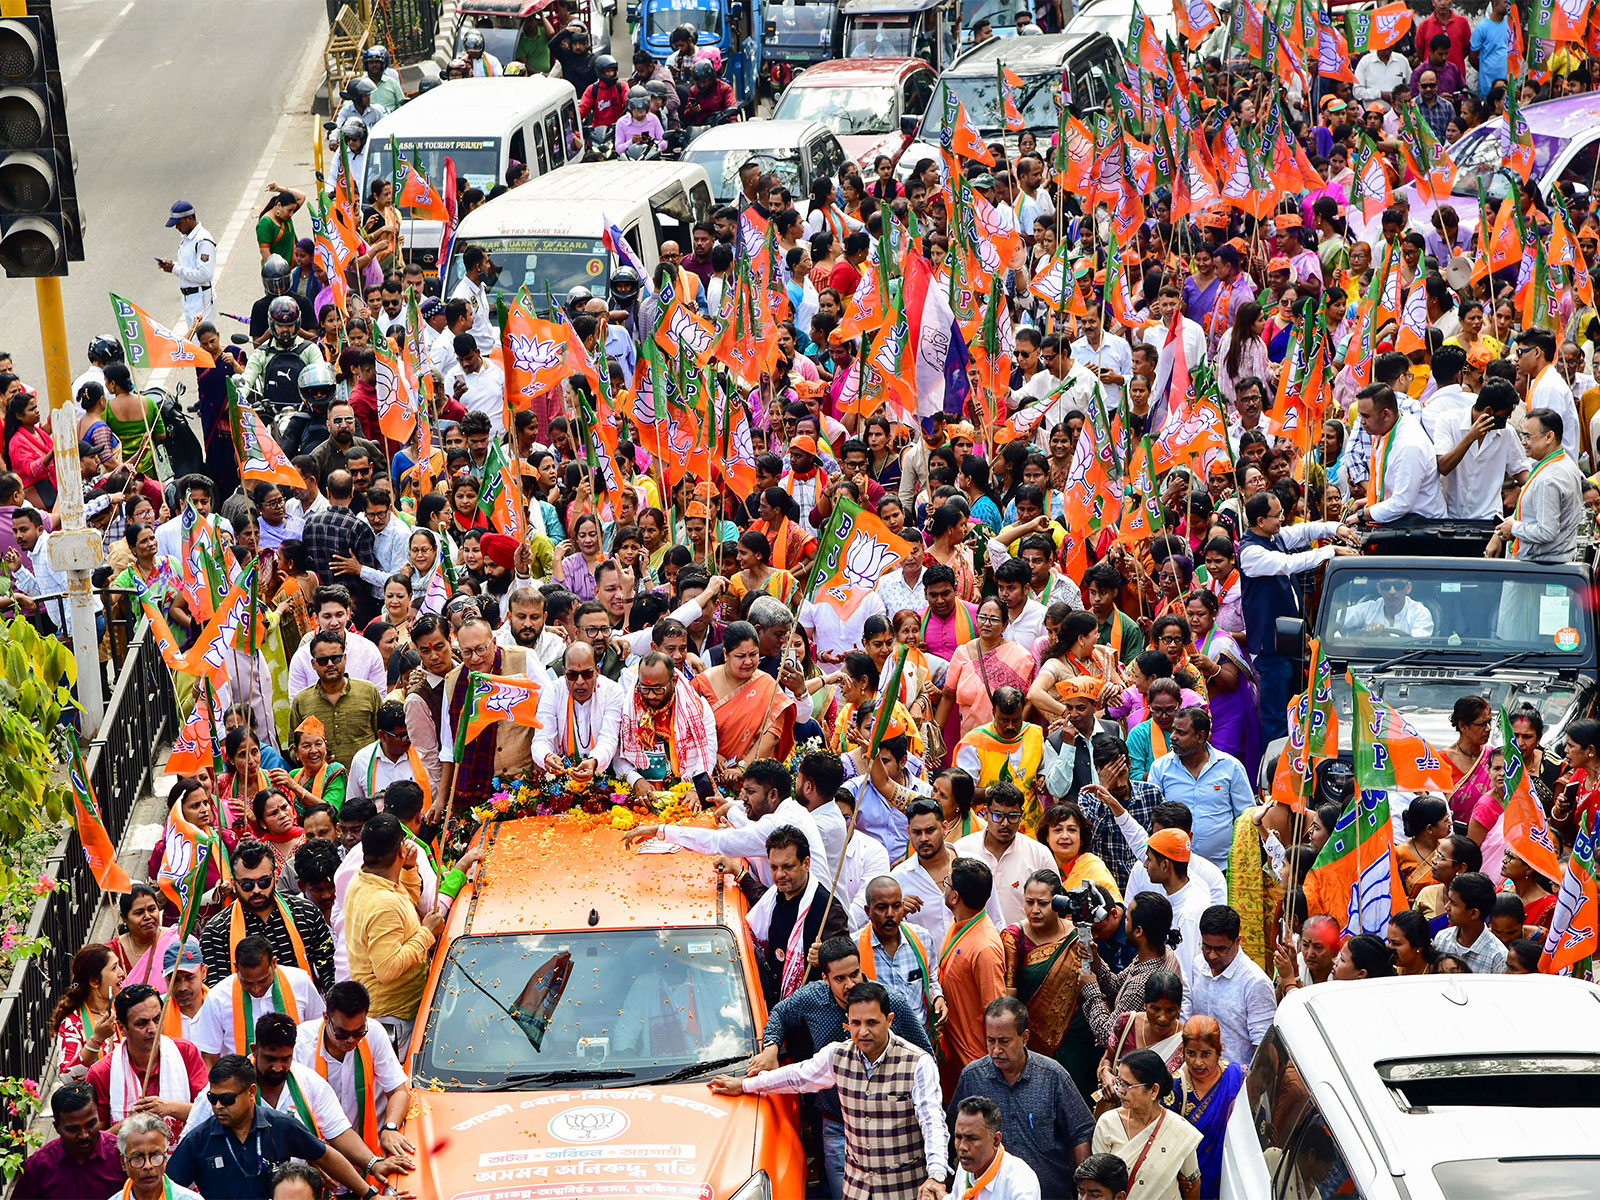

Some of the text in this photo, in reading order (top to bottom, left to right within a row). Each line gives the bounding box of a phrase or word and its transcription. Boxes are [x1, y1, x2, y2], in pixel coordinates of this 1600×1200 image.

[1354, 13, 1370, 48] BJP
[399, 141, 423, 150] ASSM
[424, 141, 455, 150] TOURIST
[455, 141, 484, 150] PERMIT
[502, 240, 539, 248] QUARRY
[557, 241, 588, 249] AZARA
[590, 260, 600, 273] 6
[114, 300, 144, 364] BJP
[487, 1153, 529, 1164] অটল
[545, 1147, 603, 1160] অবিচল
[653, 1159, 697, 1176] গতি
